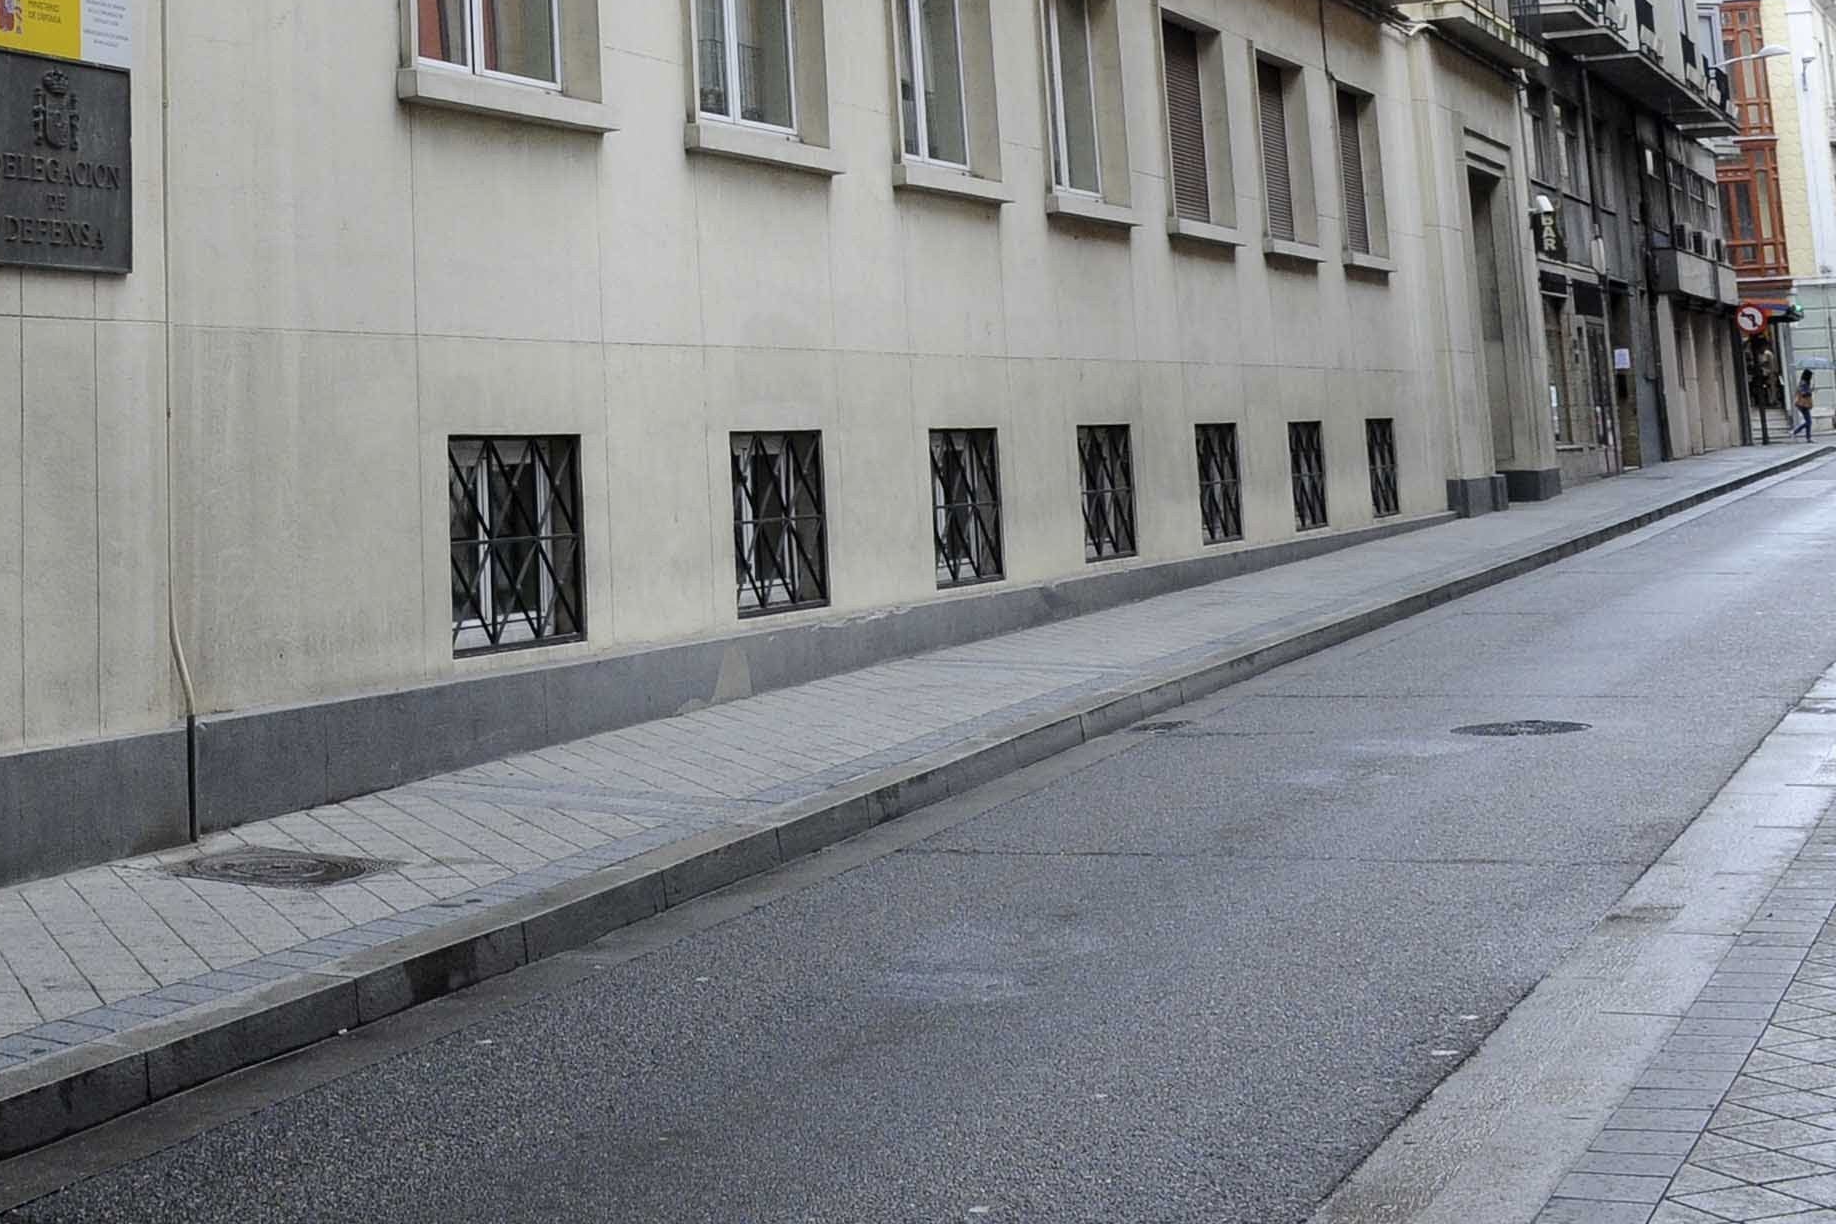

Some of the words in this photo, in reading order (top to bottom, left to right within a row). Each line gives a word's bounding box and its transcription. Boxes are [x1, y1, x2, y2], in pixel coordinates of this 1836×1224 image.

[46, 192, 67, 213] DE
[4, 214, 105, 251] DEFENSA
[1541, 214, 1556, 251] BAR
